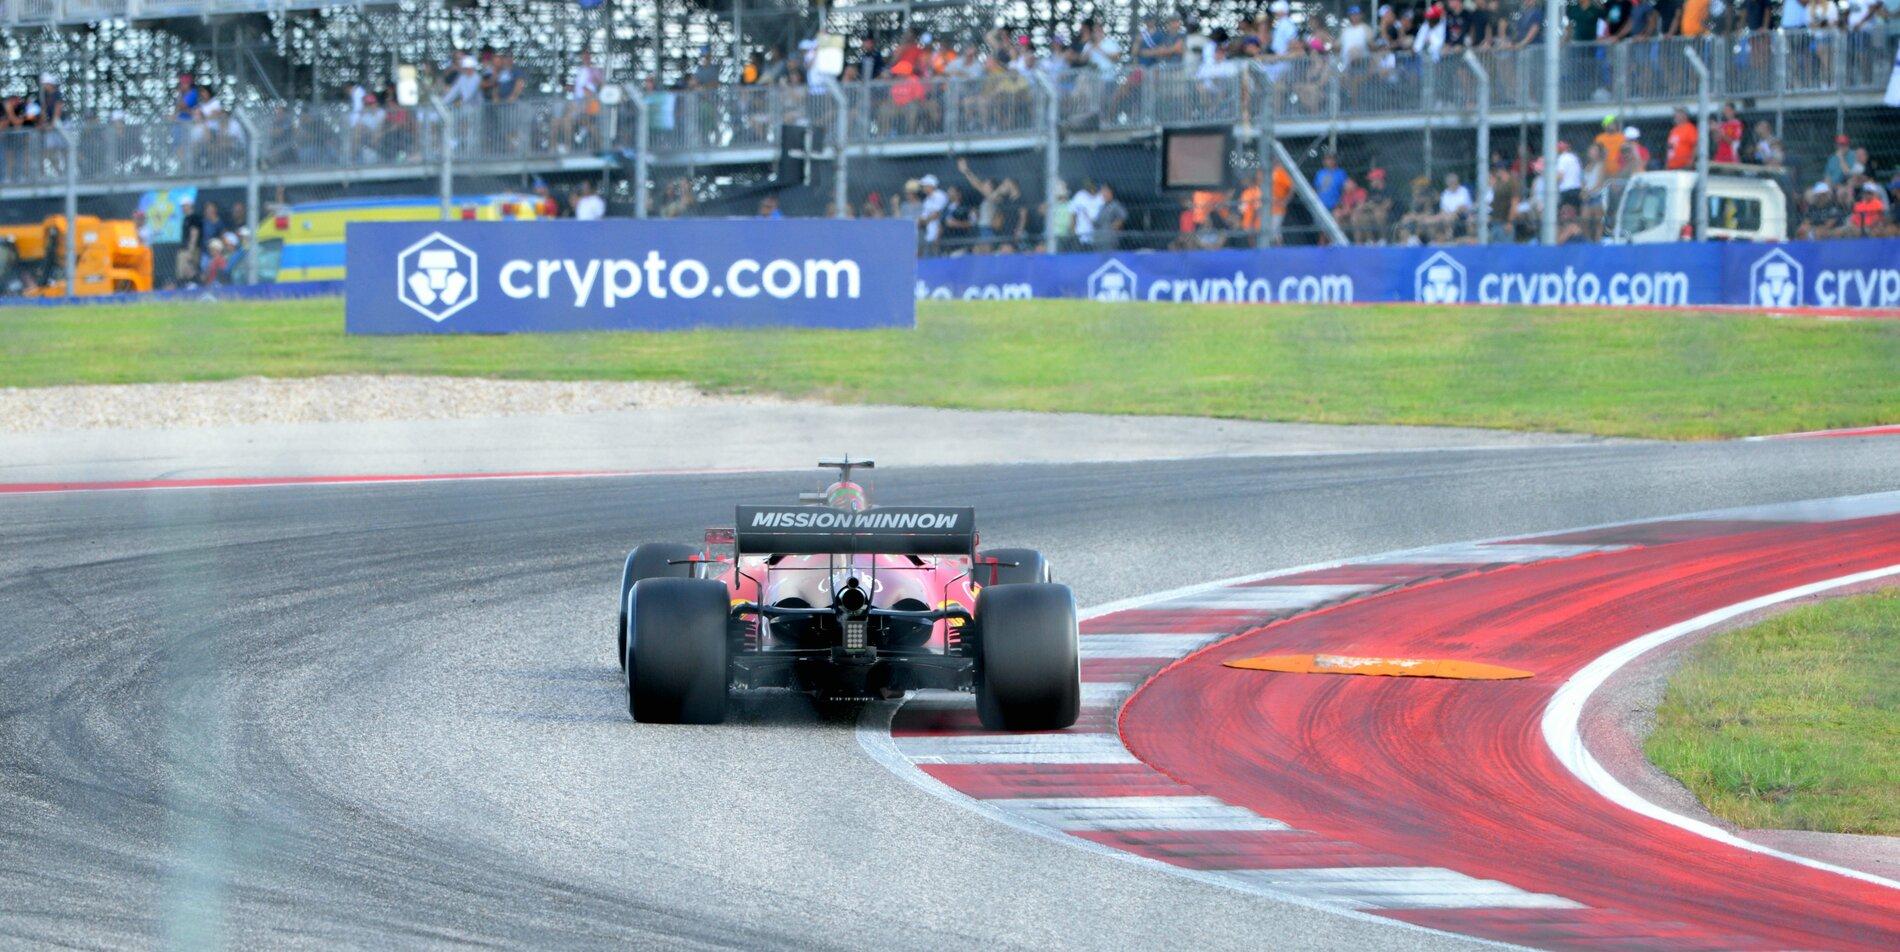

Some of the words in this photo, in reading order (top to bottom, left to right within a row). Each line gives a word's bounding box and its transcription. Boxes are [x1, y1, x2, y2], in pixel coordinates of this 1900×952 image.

[499, 250, 860, 307] crypto.com
[1148, 270, 1354, 303] cryptocom
[752, 512, 851, 528] MISSION
[853, 513, 959, 529] WINNOW
